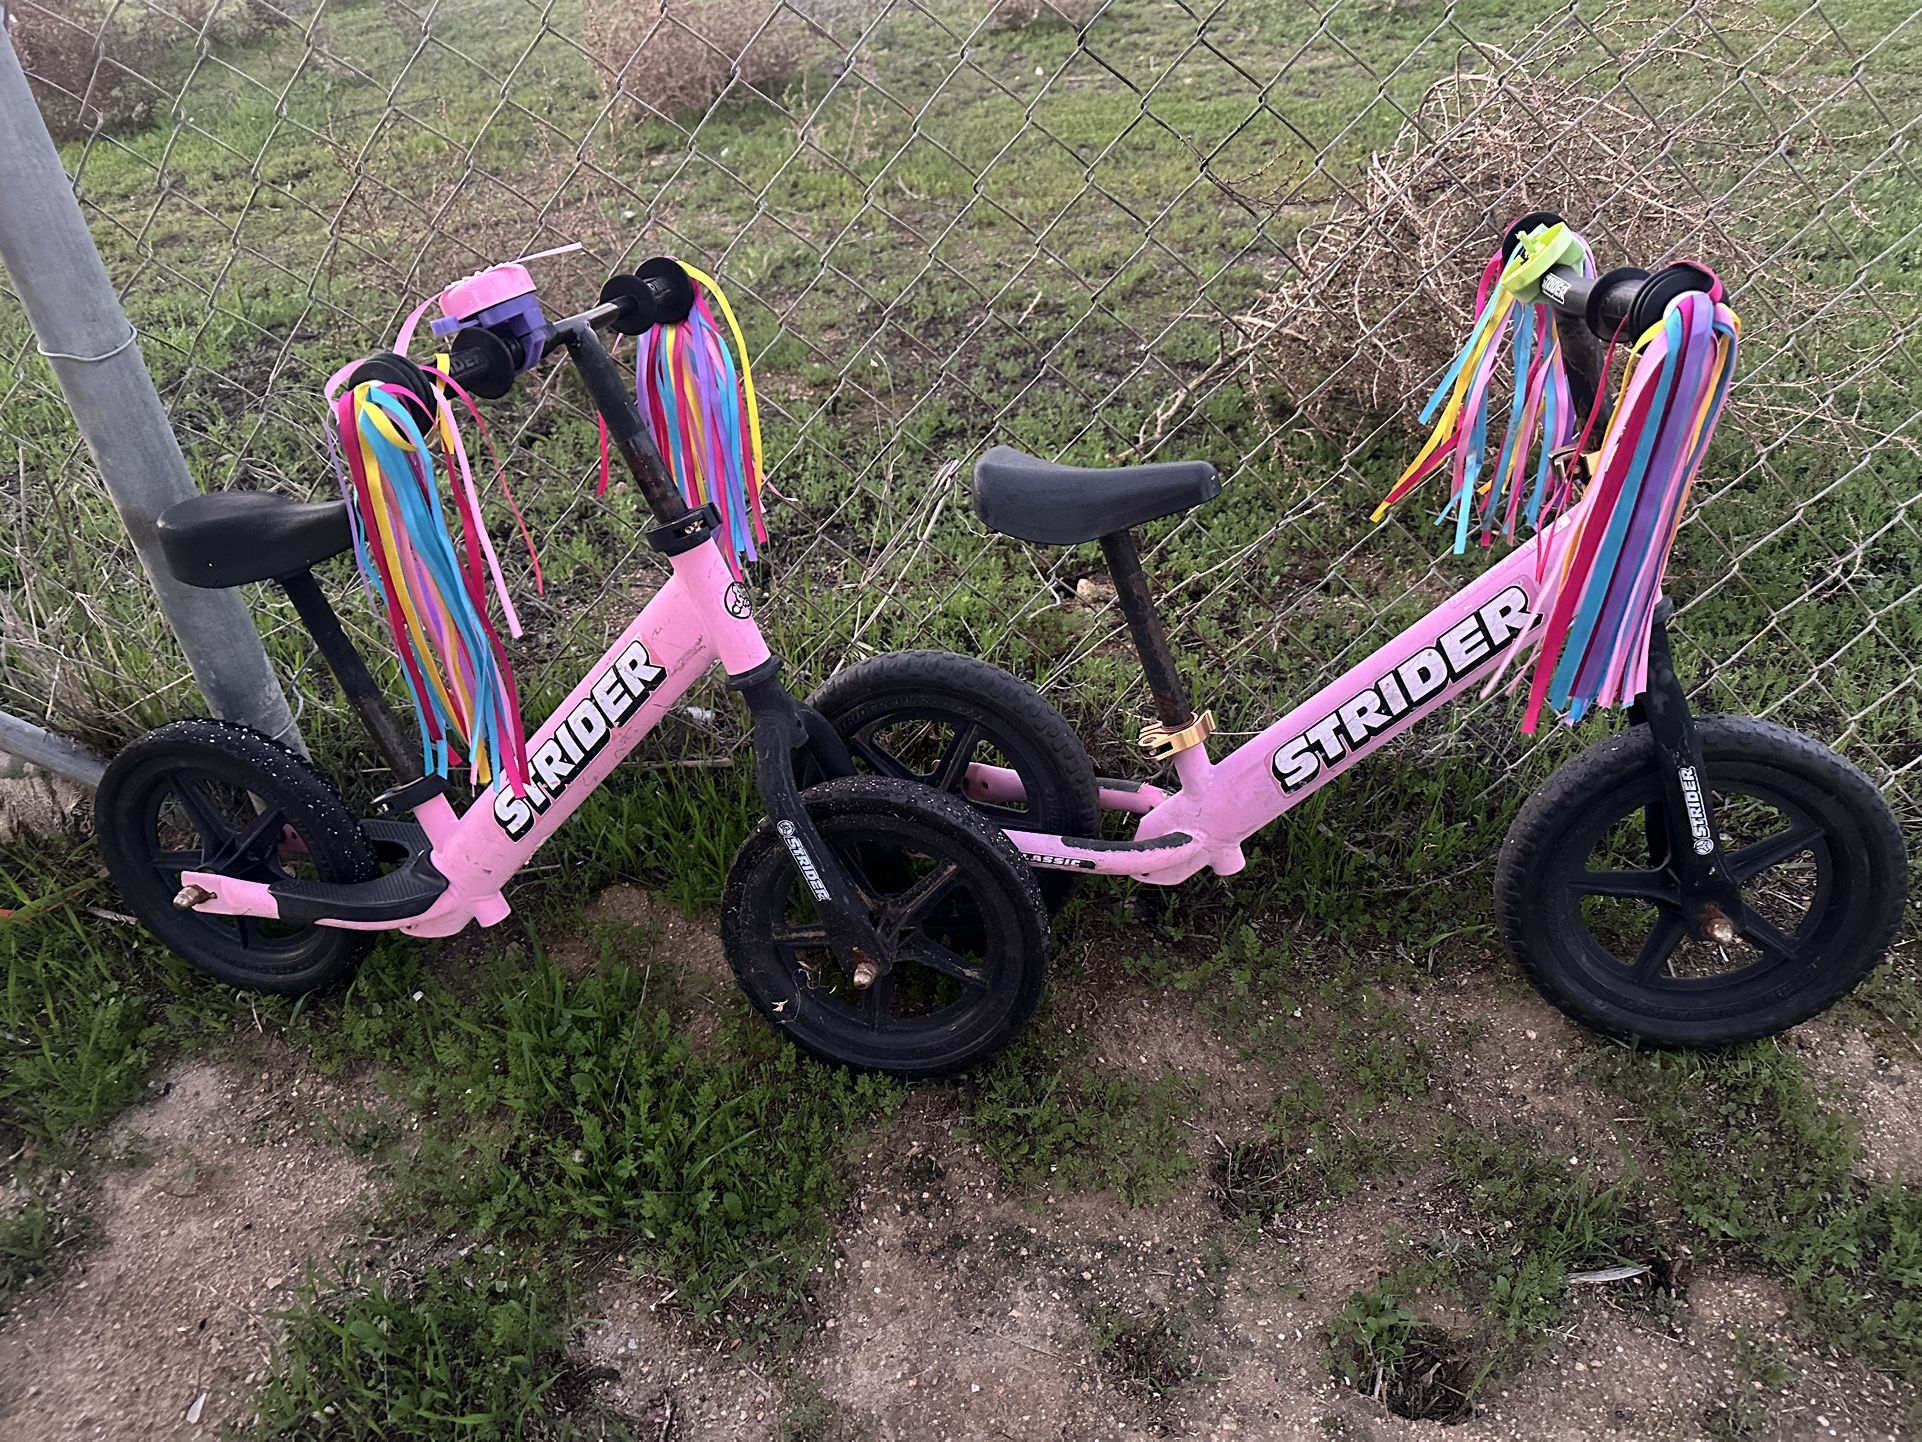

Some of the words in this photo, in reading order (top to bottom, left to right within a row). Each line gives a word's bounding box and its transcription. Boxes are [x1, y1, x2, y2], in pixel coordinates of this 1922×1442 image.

[1271, 585, 1543, 795] STRIDER
[493, 639, 668, 843] STRIDER
[1679, 766, 1711, 839] STRIDER
[783, 836, 832, 901] STRIDER
[1020, 853, 1082, 868] LASSIC
